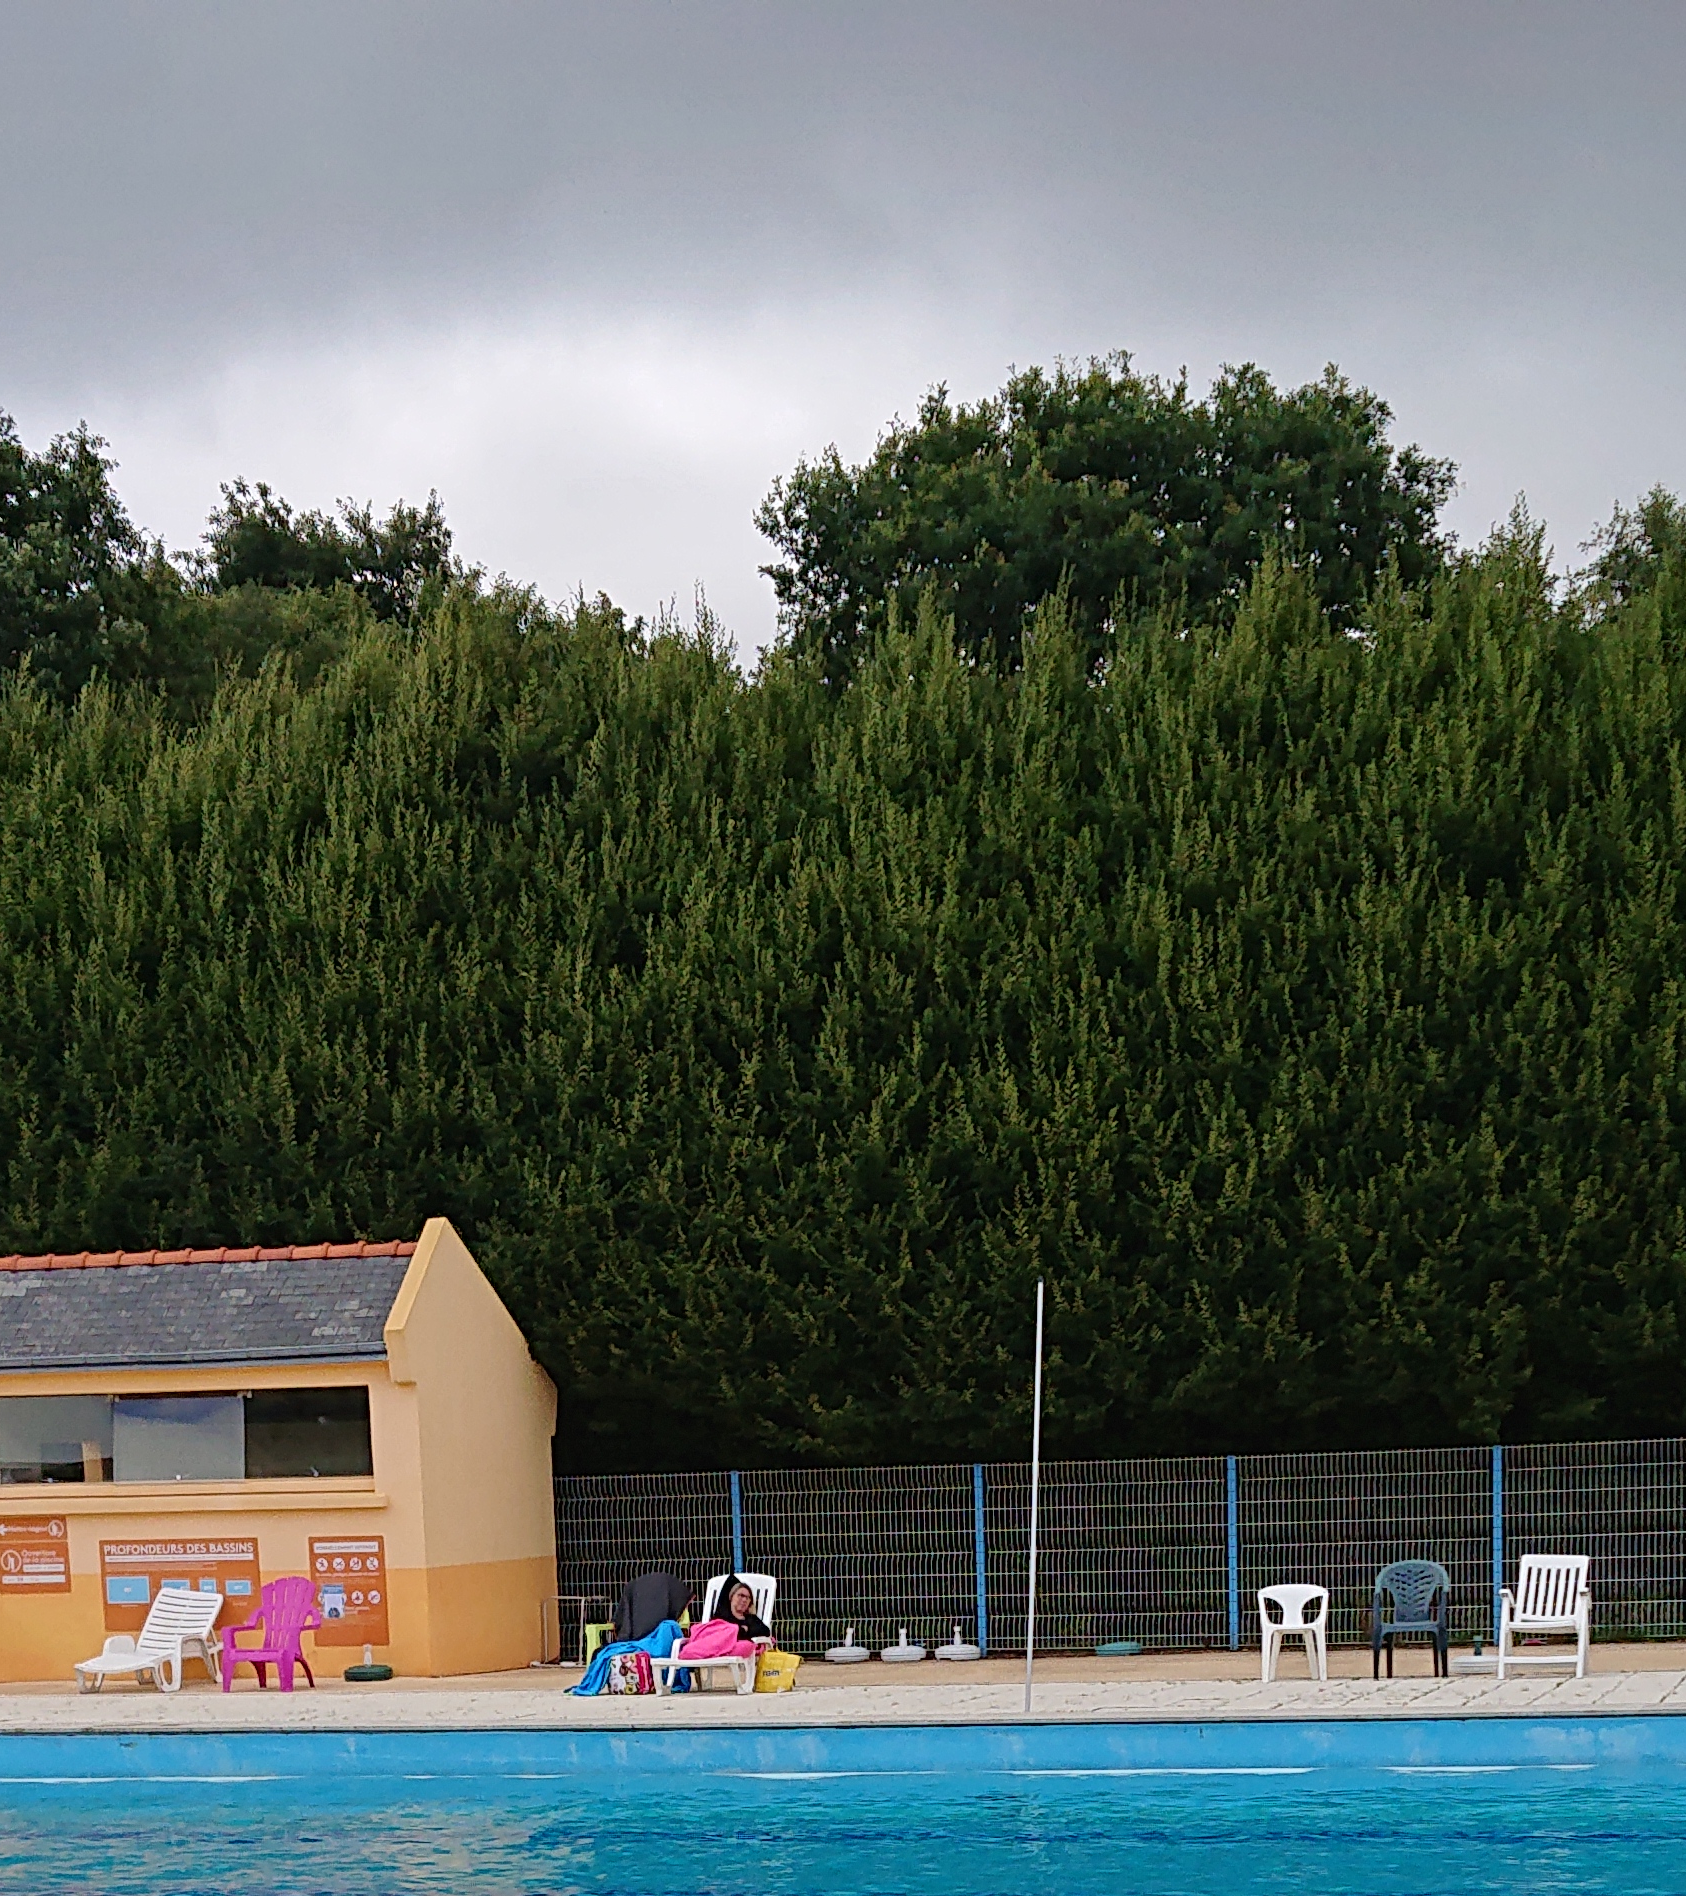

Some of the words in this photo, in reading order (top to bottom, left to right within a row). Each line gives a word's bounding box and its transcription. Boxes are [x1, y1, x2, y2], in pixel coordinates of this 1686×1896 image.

[103, 1544, 184, 1555] PROFONDEURS
[186, 1543, 207, 1554] DES
[209, 1542, 254, 1553] BASSINS
